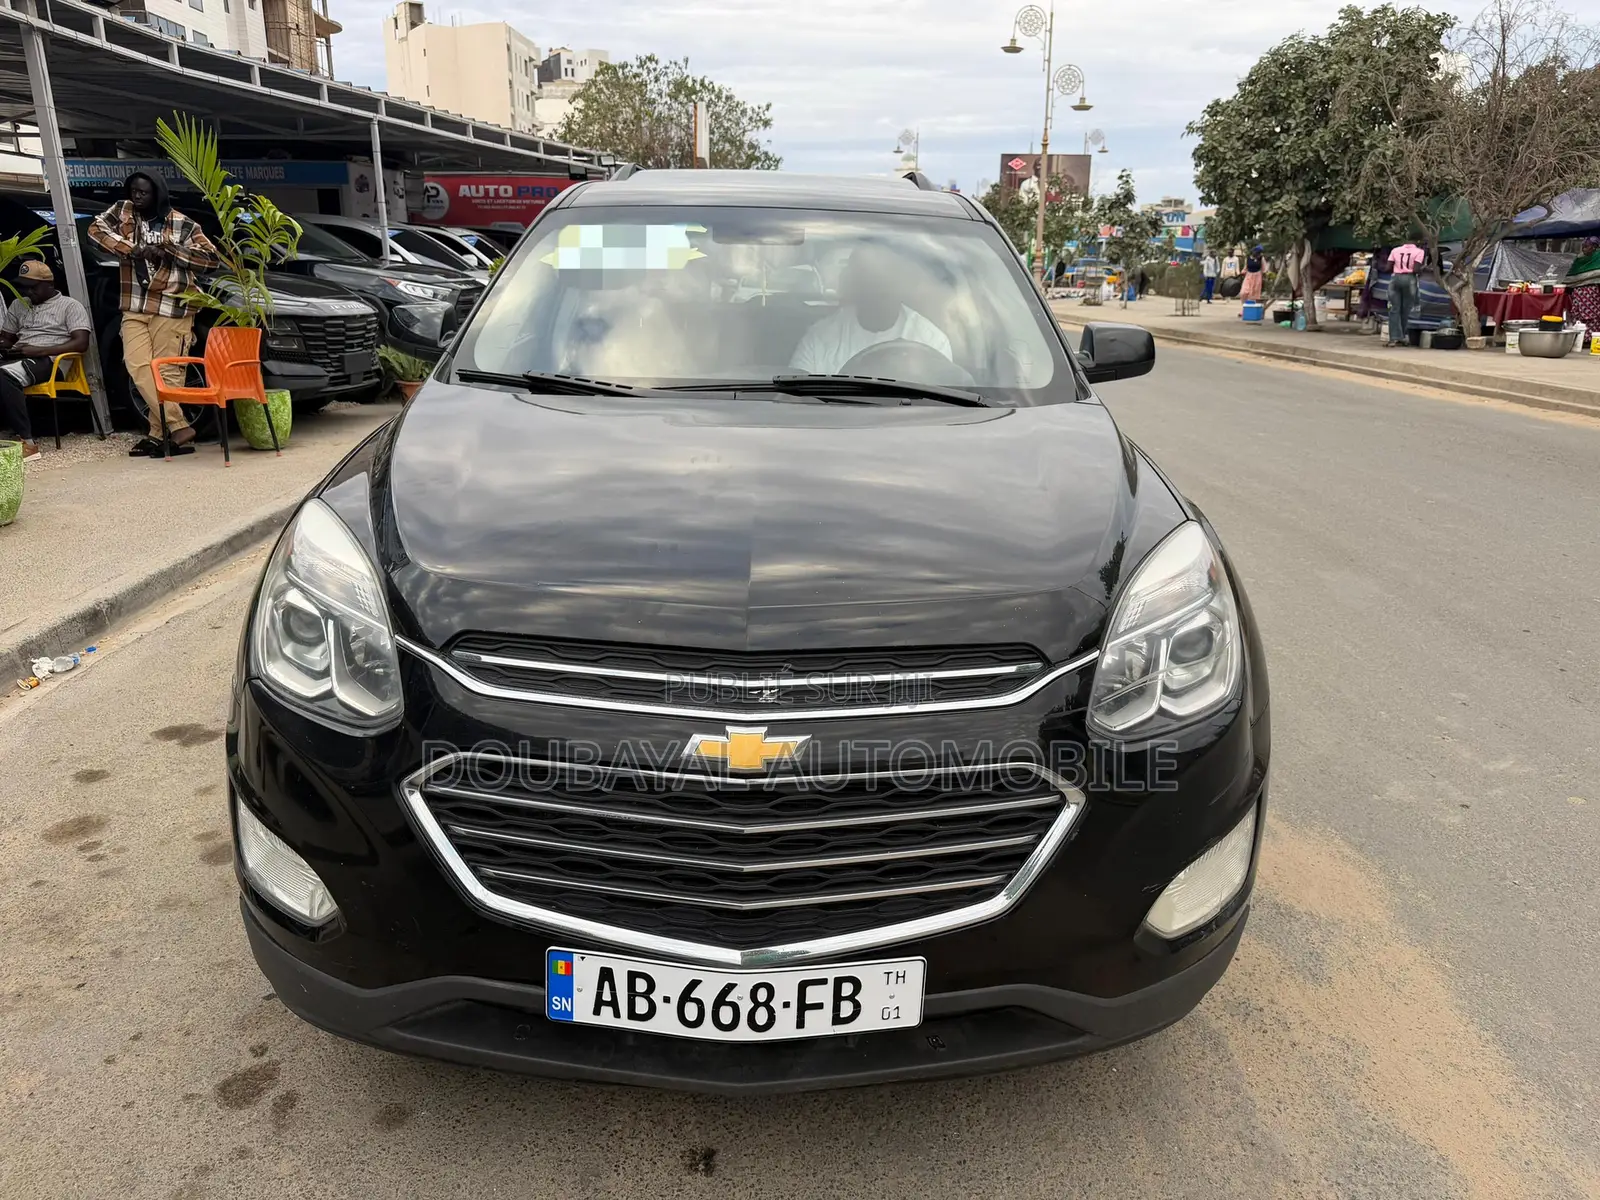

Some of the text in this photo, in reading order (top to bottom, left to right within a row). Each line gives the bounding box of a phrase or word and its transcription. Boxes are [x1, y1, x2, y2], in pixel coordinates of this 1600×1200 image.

[85, 165, 125, 178] LOCATION
[245, 166, 285, 180] MARQUES
[459, 185, 559, 198] AUTO PRO
[1400, 253, 1411, 269] 11
[883, 970, 907, 985] TH
[551, 995, 572, 1012] SN
